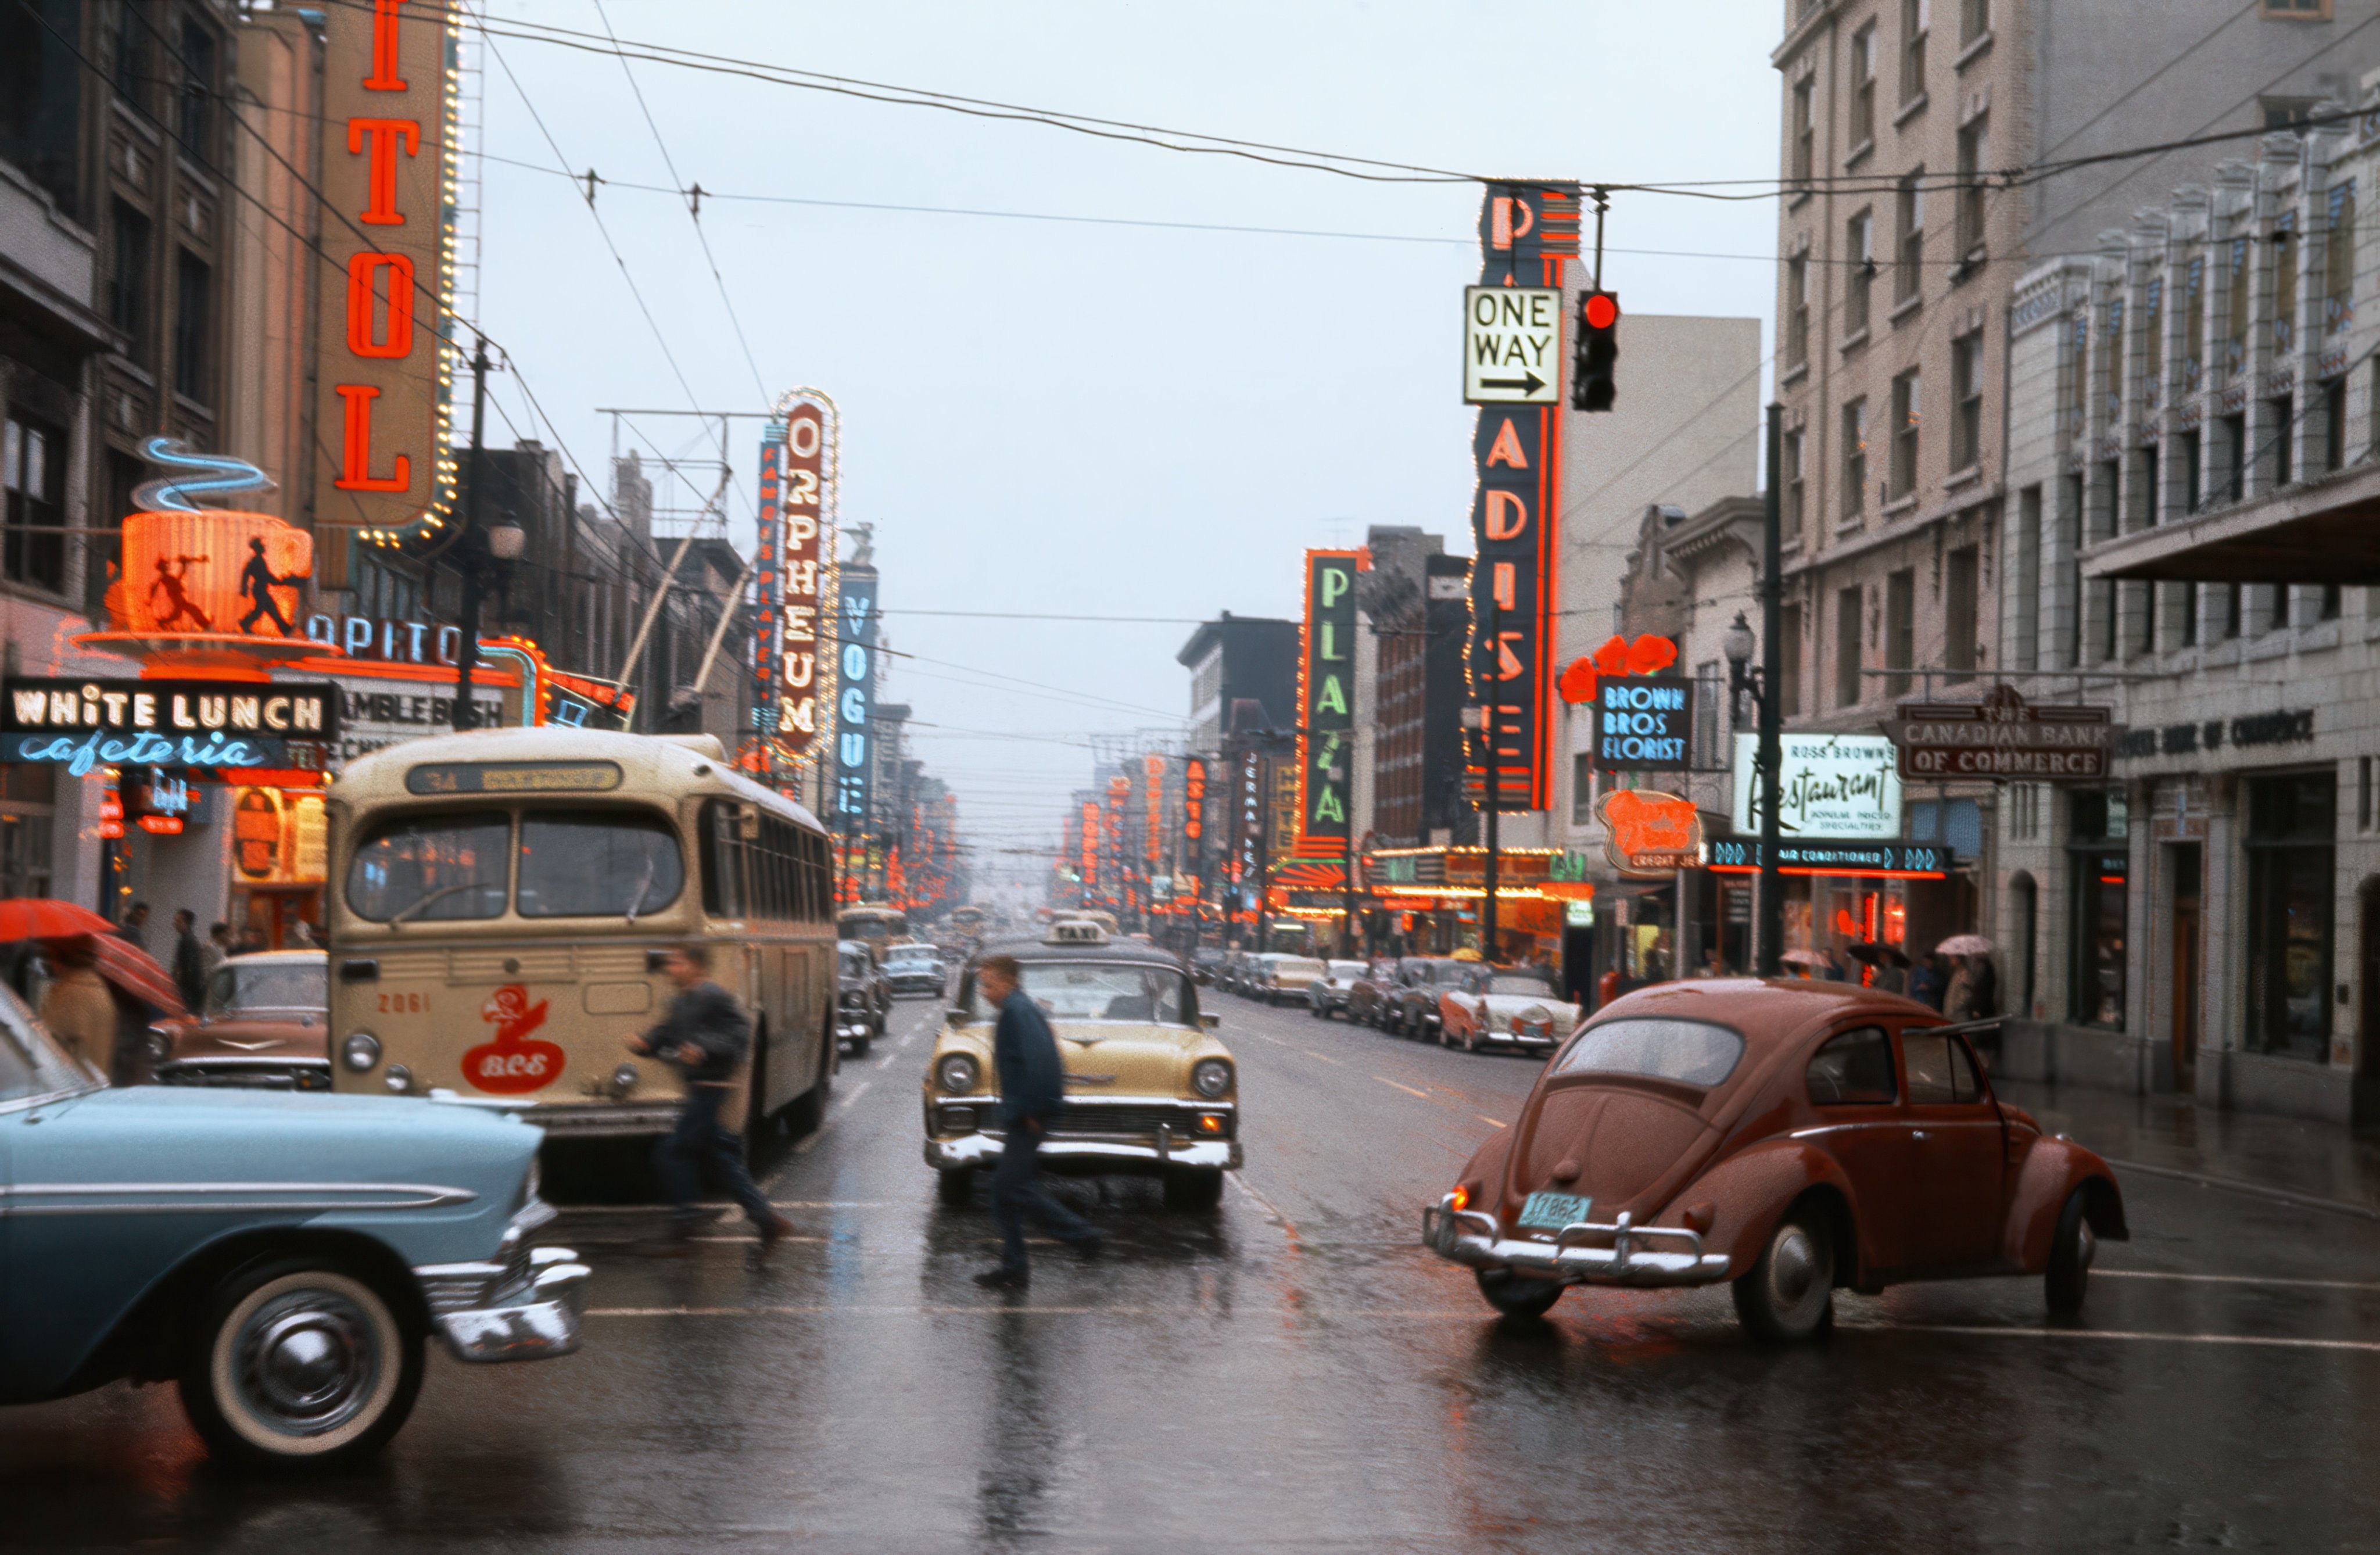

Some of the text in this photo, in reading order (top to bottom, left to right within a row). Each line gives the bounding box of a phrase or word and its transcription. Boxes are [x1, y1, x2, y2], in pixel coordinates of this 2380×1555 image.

[1474, 293, 1551, 328] ONE
[1474, 334, 1553, 367] WAY
[1481, 195, 1534, 755] PADISE
[779, 416, 821, 733] ORPHEUM
[838, 596, 869, 814] VOGUE
[1315, 567, 1349, 823] PLAZA
[1604, 686, 1686, 711] BROWN
[172, 694, 322, 730] LUNCH
[1603, 712, 1668, 736] BROS
[1981, 707, 2031, 723] THE
[1602, 737, 1686, 761] FLORIST
[1904, 723, 2031, 746] CANADIAN
[2041, 725, 2110, 746] BANK
[19, 729, 265, 777] cafeteria
[1790, 746, 1827, 759] ROSS
[1914, 750, 2098, 773] OF COMMERCE
[1056, 927, 1098, 940] TAXI
